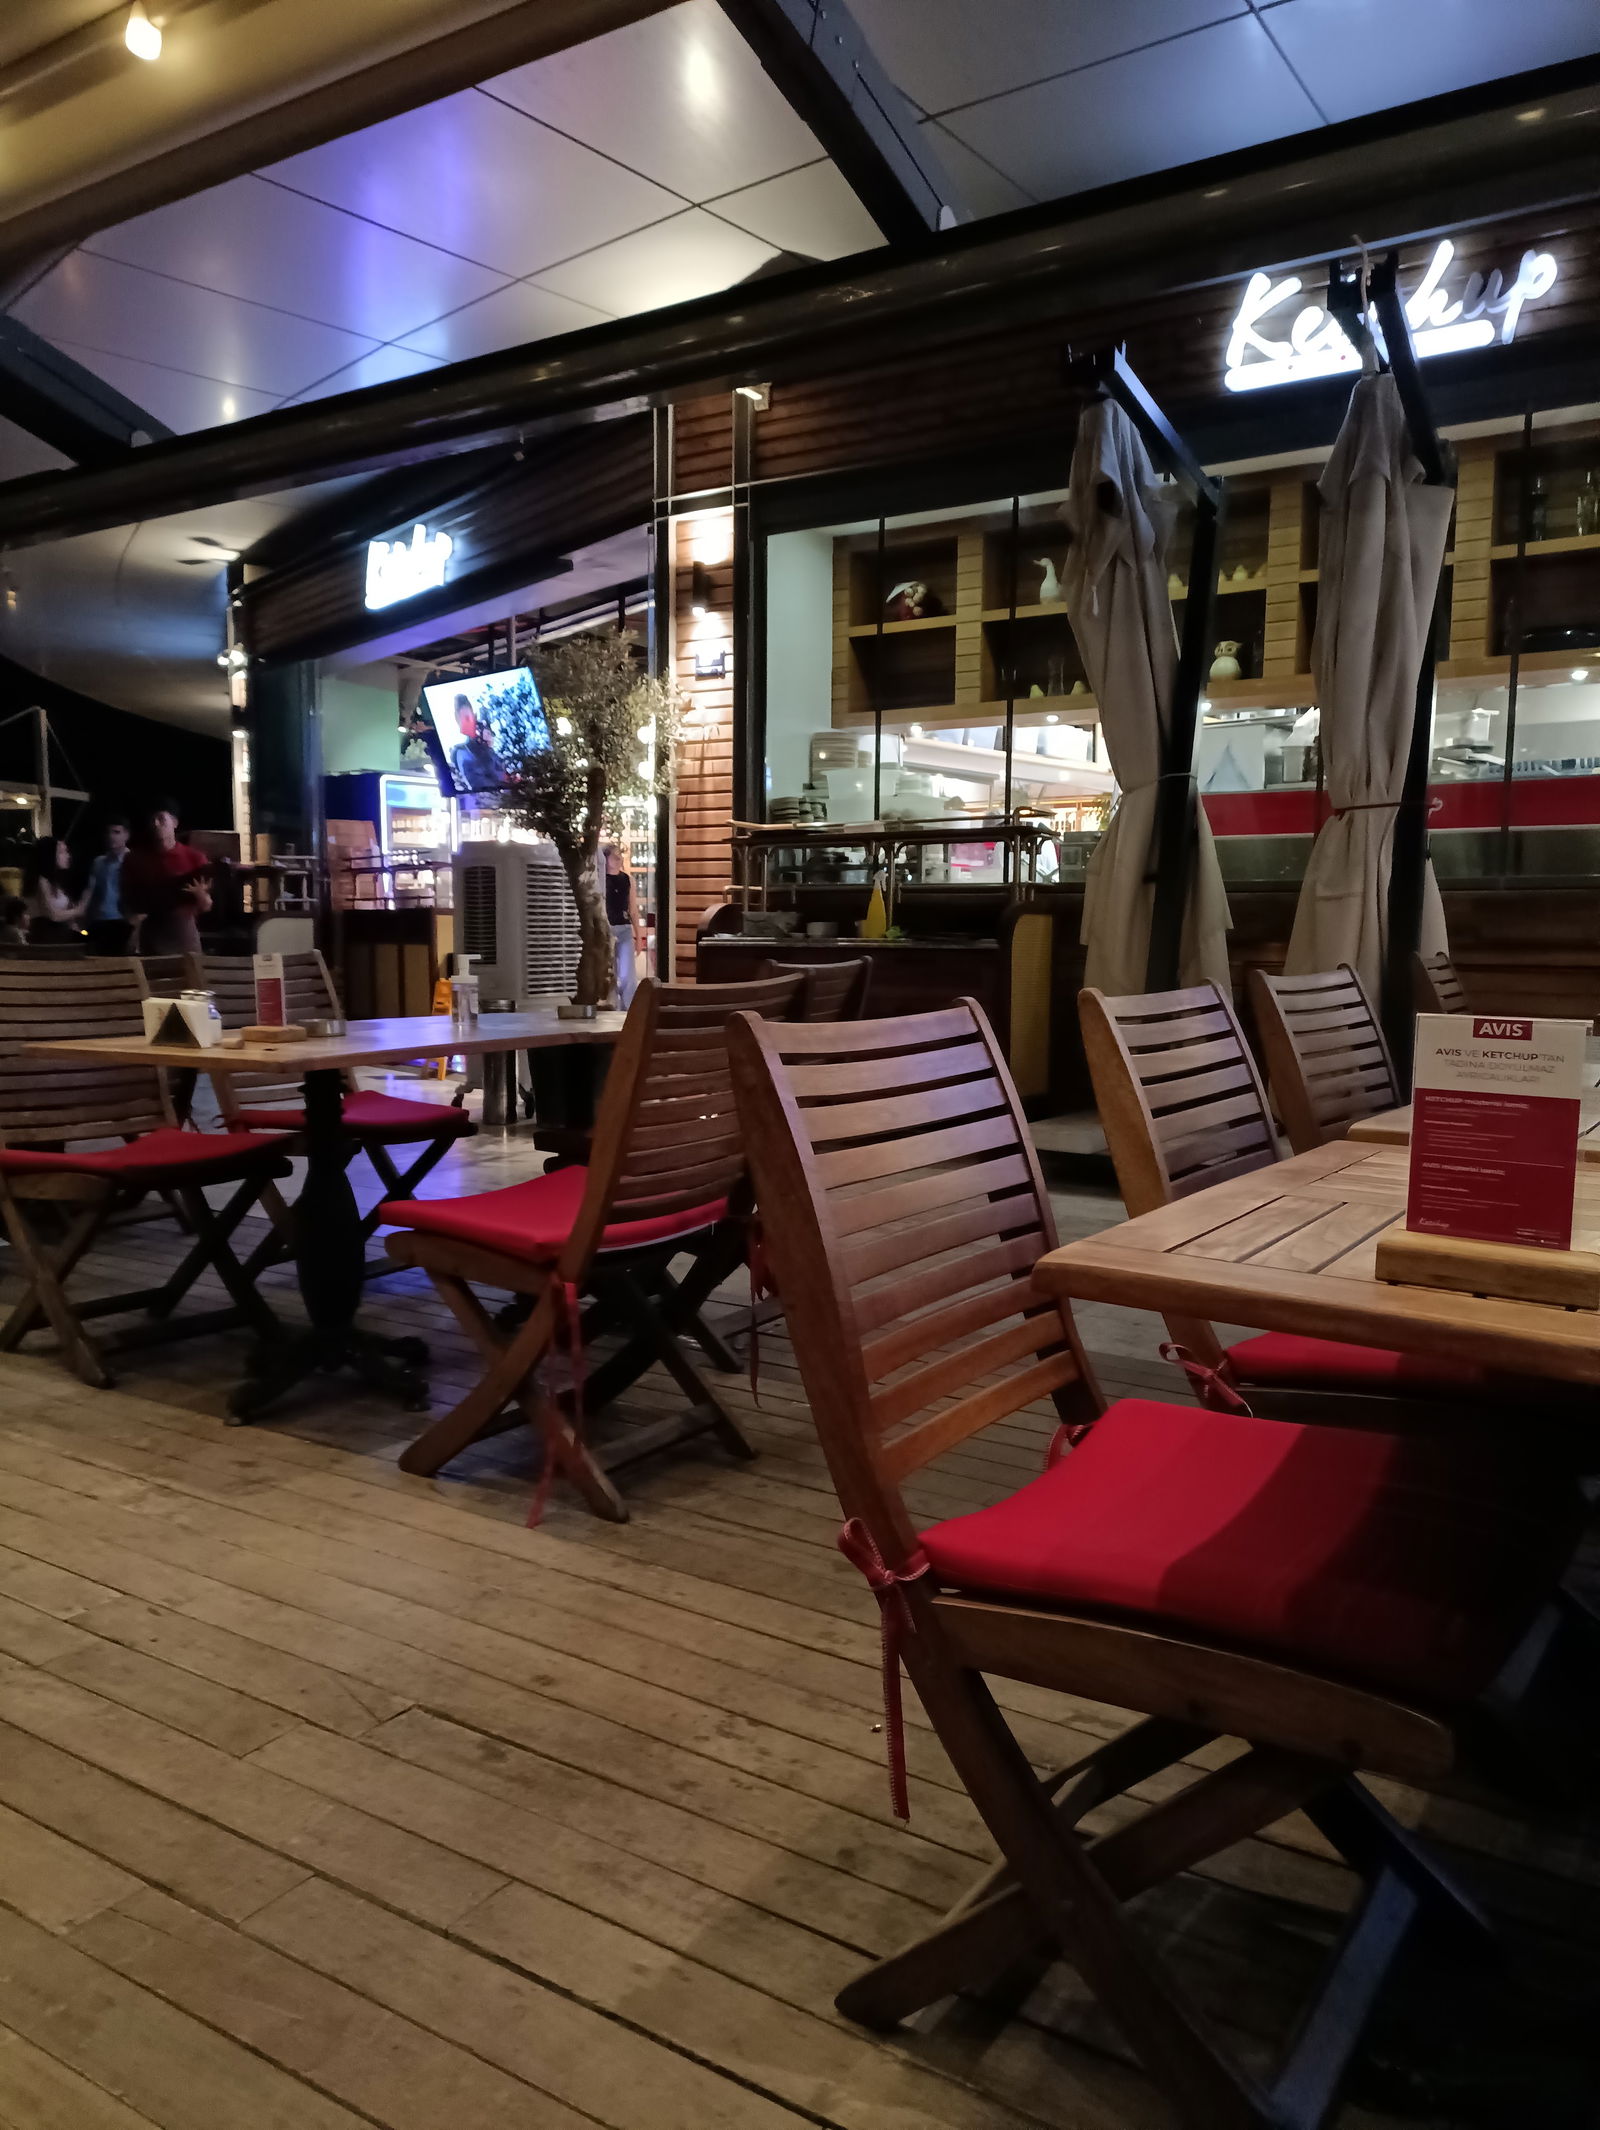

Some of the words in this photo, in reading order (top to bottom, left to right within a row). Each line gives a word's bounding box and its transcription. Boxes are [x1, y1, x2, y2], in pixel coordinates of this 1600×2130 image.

[1478, 1022, 1524, 1037] AVIS
[1435, 1048, 1462, 1057] AVIS
[1464, 1049, 1480, 1058] VE
